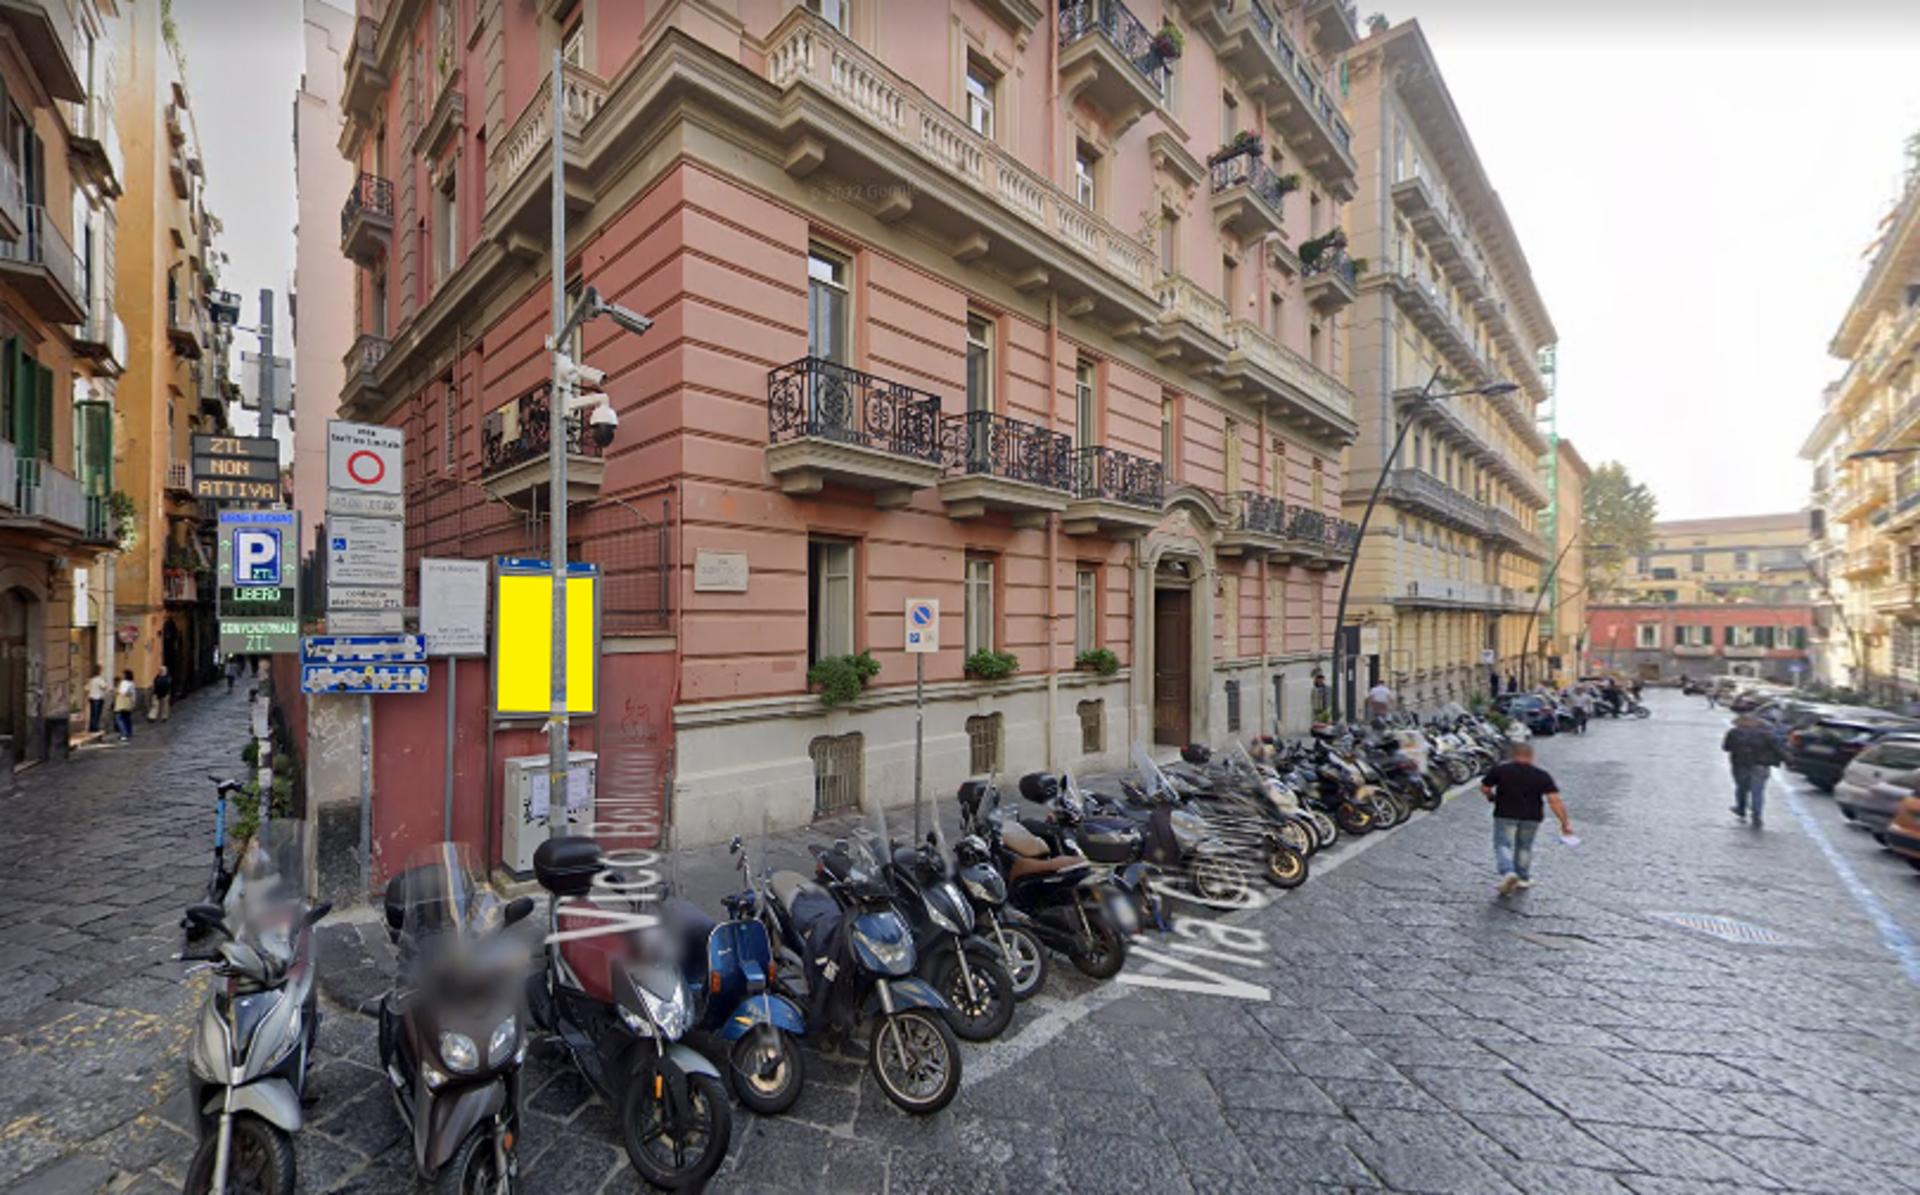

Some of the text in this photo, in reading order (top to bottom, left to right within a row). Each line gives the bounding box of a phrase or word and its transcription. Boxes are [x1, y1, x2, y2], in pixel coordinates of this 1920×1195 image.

[210, 437, 249, 454] ZTL
[210, 459, 250, 475] NON
[198, 480, 275, 499] ATTIVA
[238, 532, 277, 580] P
[252, 568, 276, 580] ZTL
[233, 587, 281, 601] LIBERO
[245, 635, 273, 651] ZTL
